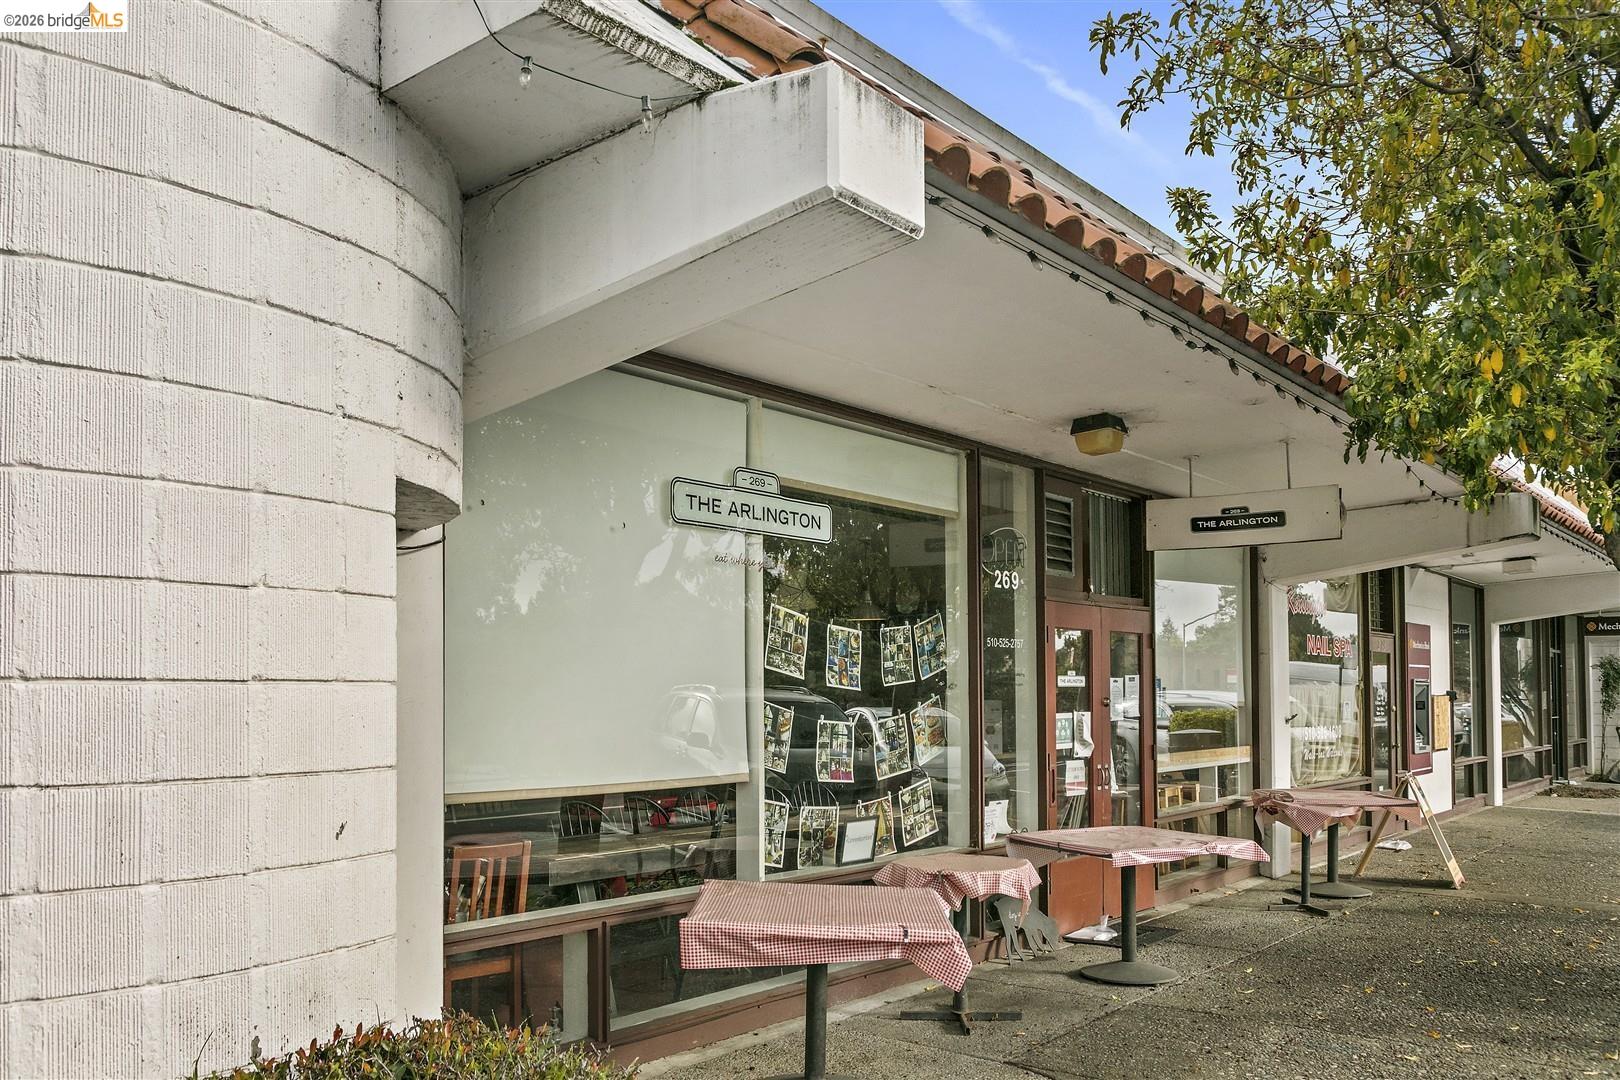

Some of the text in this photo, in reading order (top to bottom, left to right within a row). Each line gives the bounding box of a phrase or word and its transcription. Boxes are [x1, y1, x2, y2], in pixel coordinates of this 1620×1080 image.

[749, 476, 766, 488] 269
[685, 493, 821, 530] THE ARLINGTON
[1219, 516, 1278, 527] ARLINGTON
[994, 569, 1019, 590] 269
[1306, 633, 1332, 656] NAIL
[1333, 636, 1352, 657] SPA
